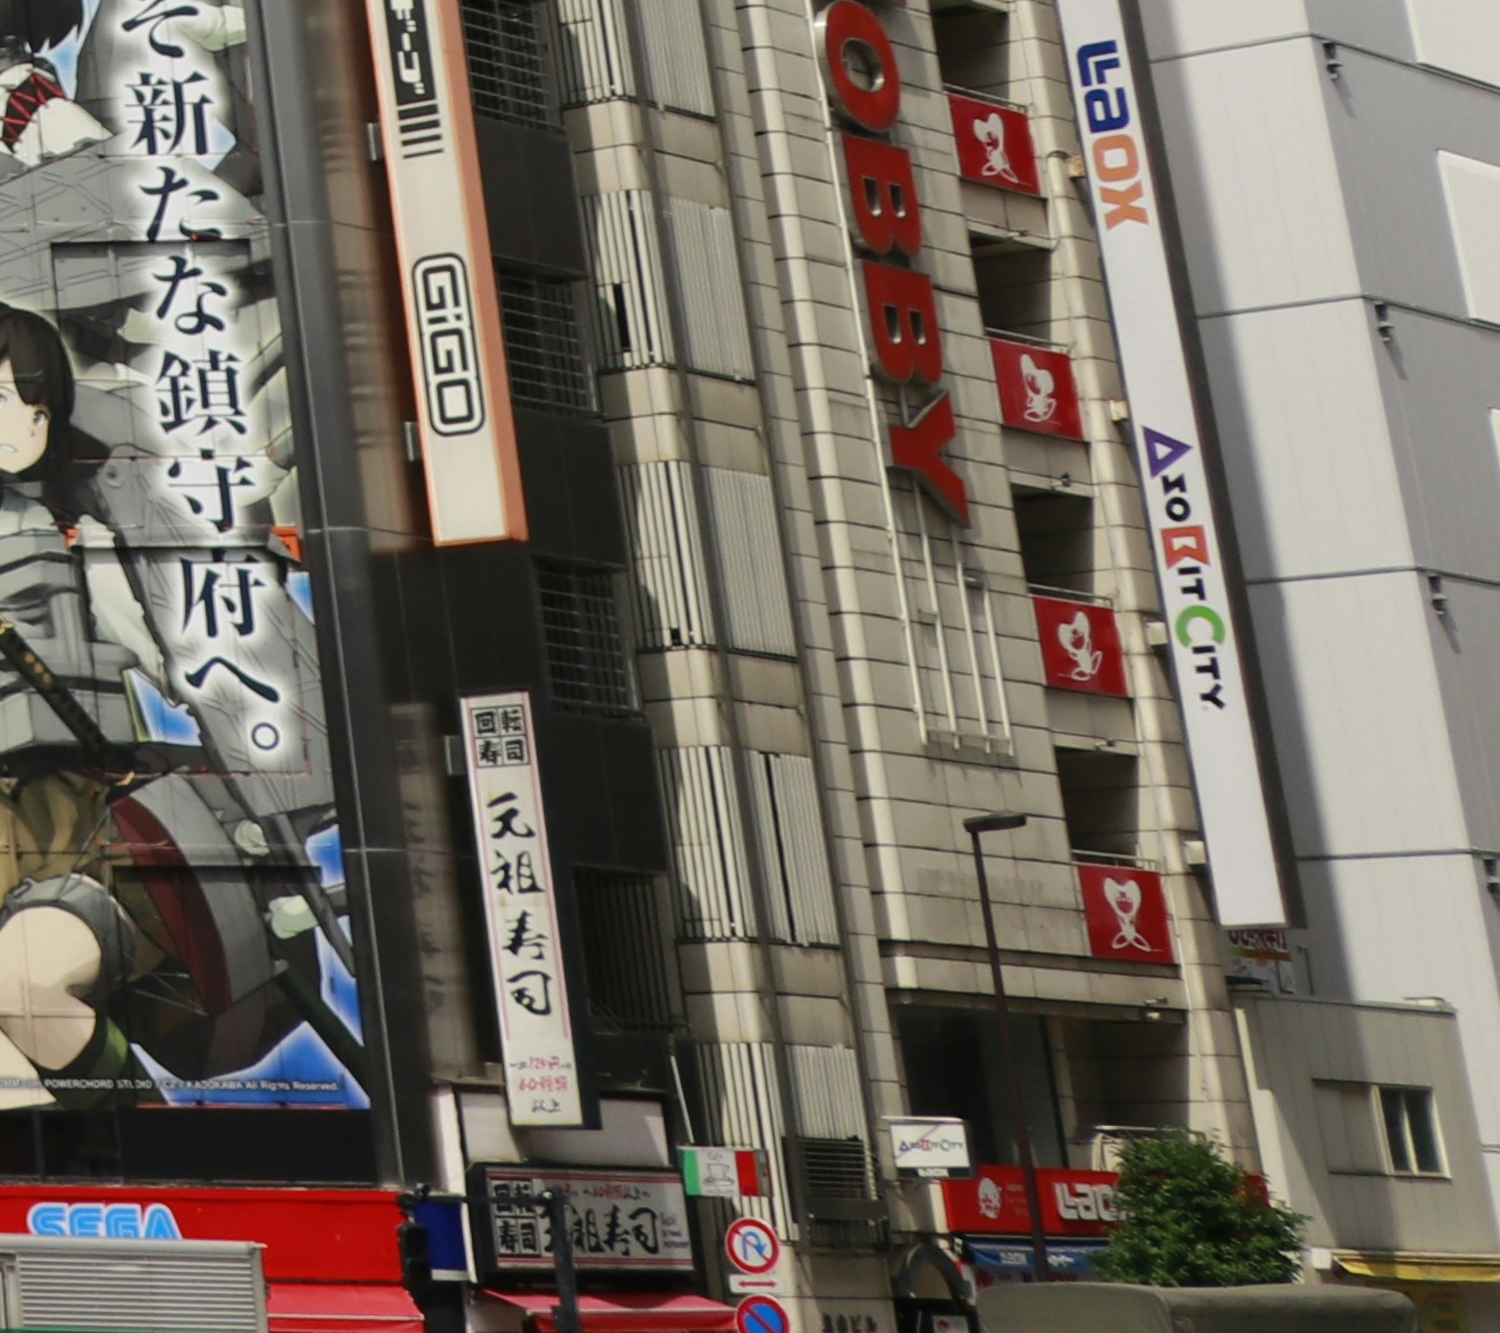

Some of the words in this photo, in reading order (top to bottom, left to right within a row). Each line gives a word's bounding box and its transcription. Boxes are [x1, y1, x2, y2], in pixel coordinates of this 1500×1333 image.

[486, 792, 554, 1017] 元祖寿司
[27, 1203, 184, 1238] SEGA
